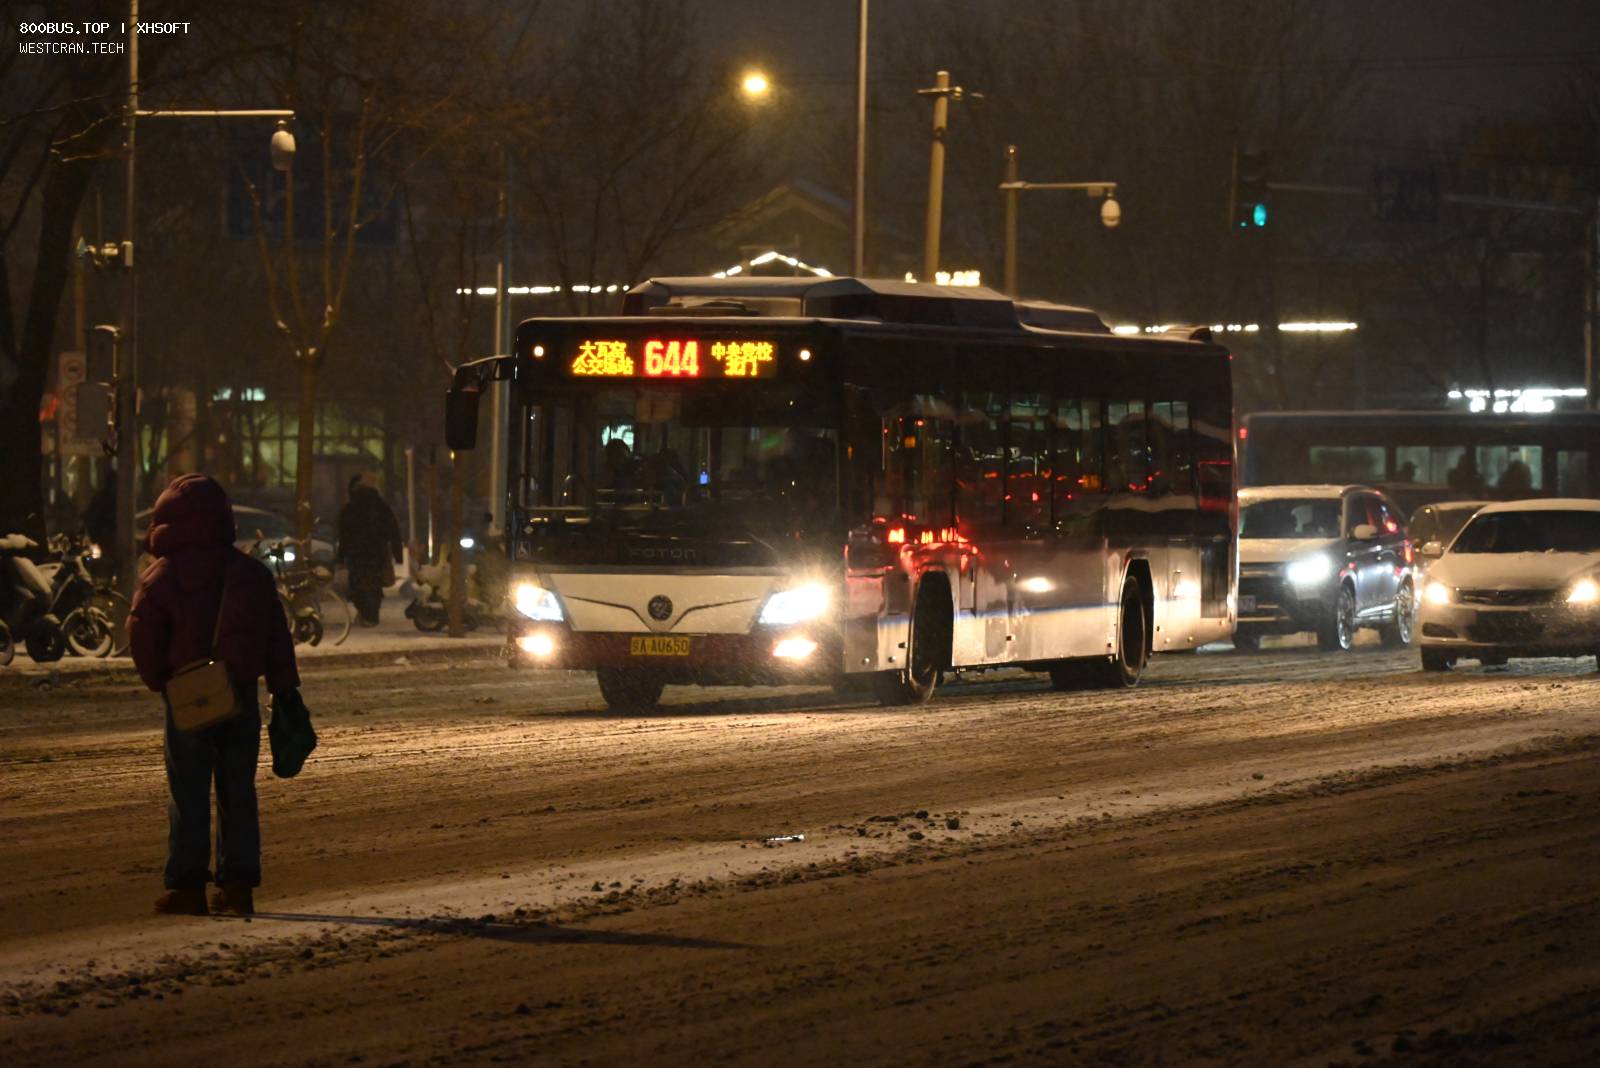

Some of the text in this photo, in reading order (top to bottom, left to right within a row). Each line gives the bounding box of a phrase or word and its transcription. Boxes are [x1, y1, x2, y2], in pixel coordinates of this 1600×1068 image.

[644, 340, 699, 376] 644
[711, 341, 773, 361] 中央党校
[572, 356, 634, 375] 公交场站
[724, 357, 758, 376] 北门
